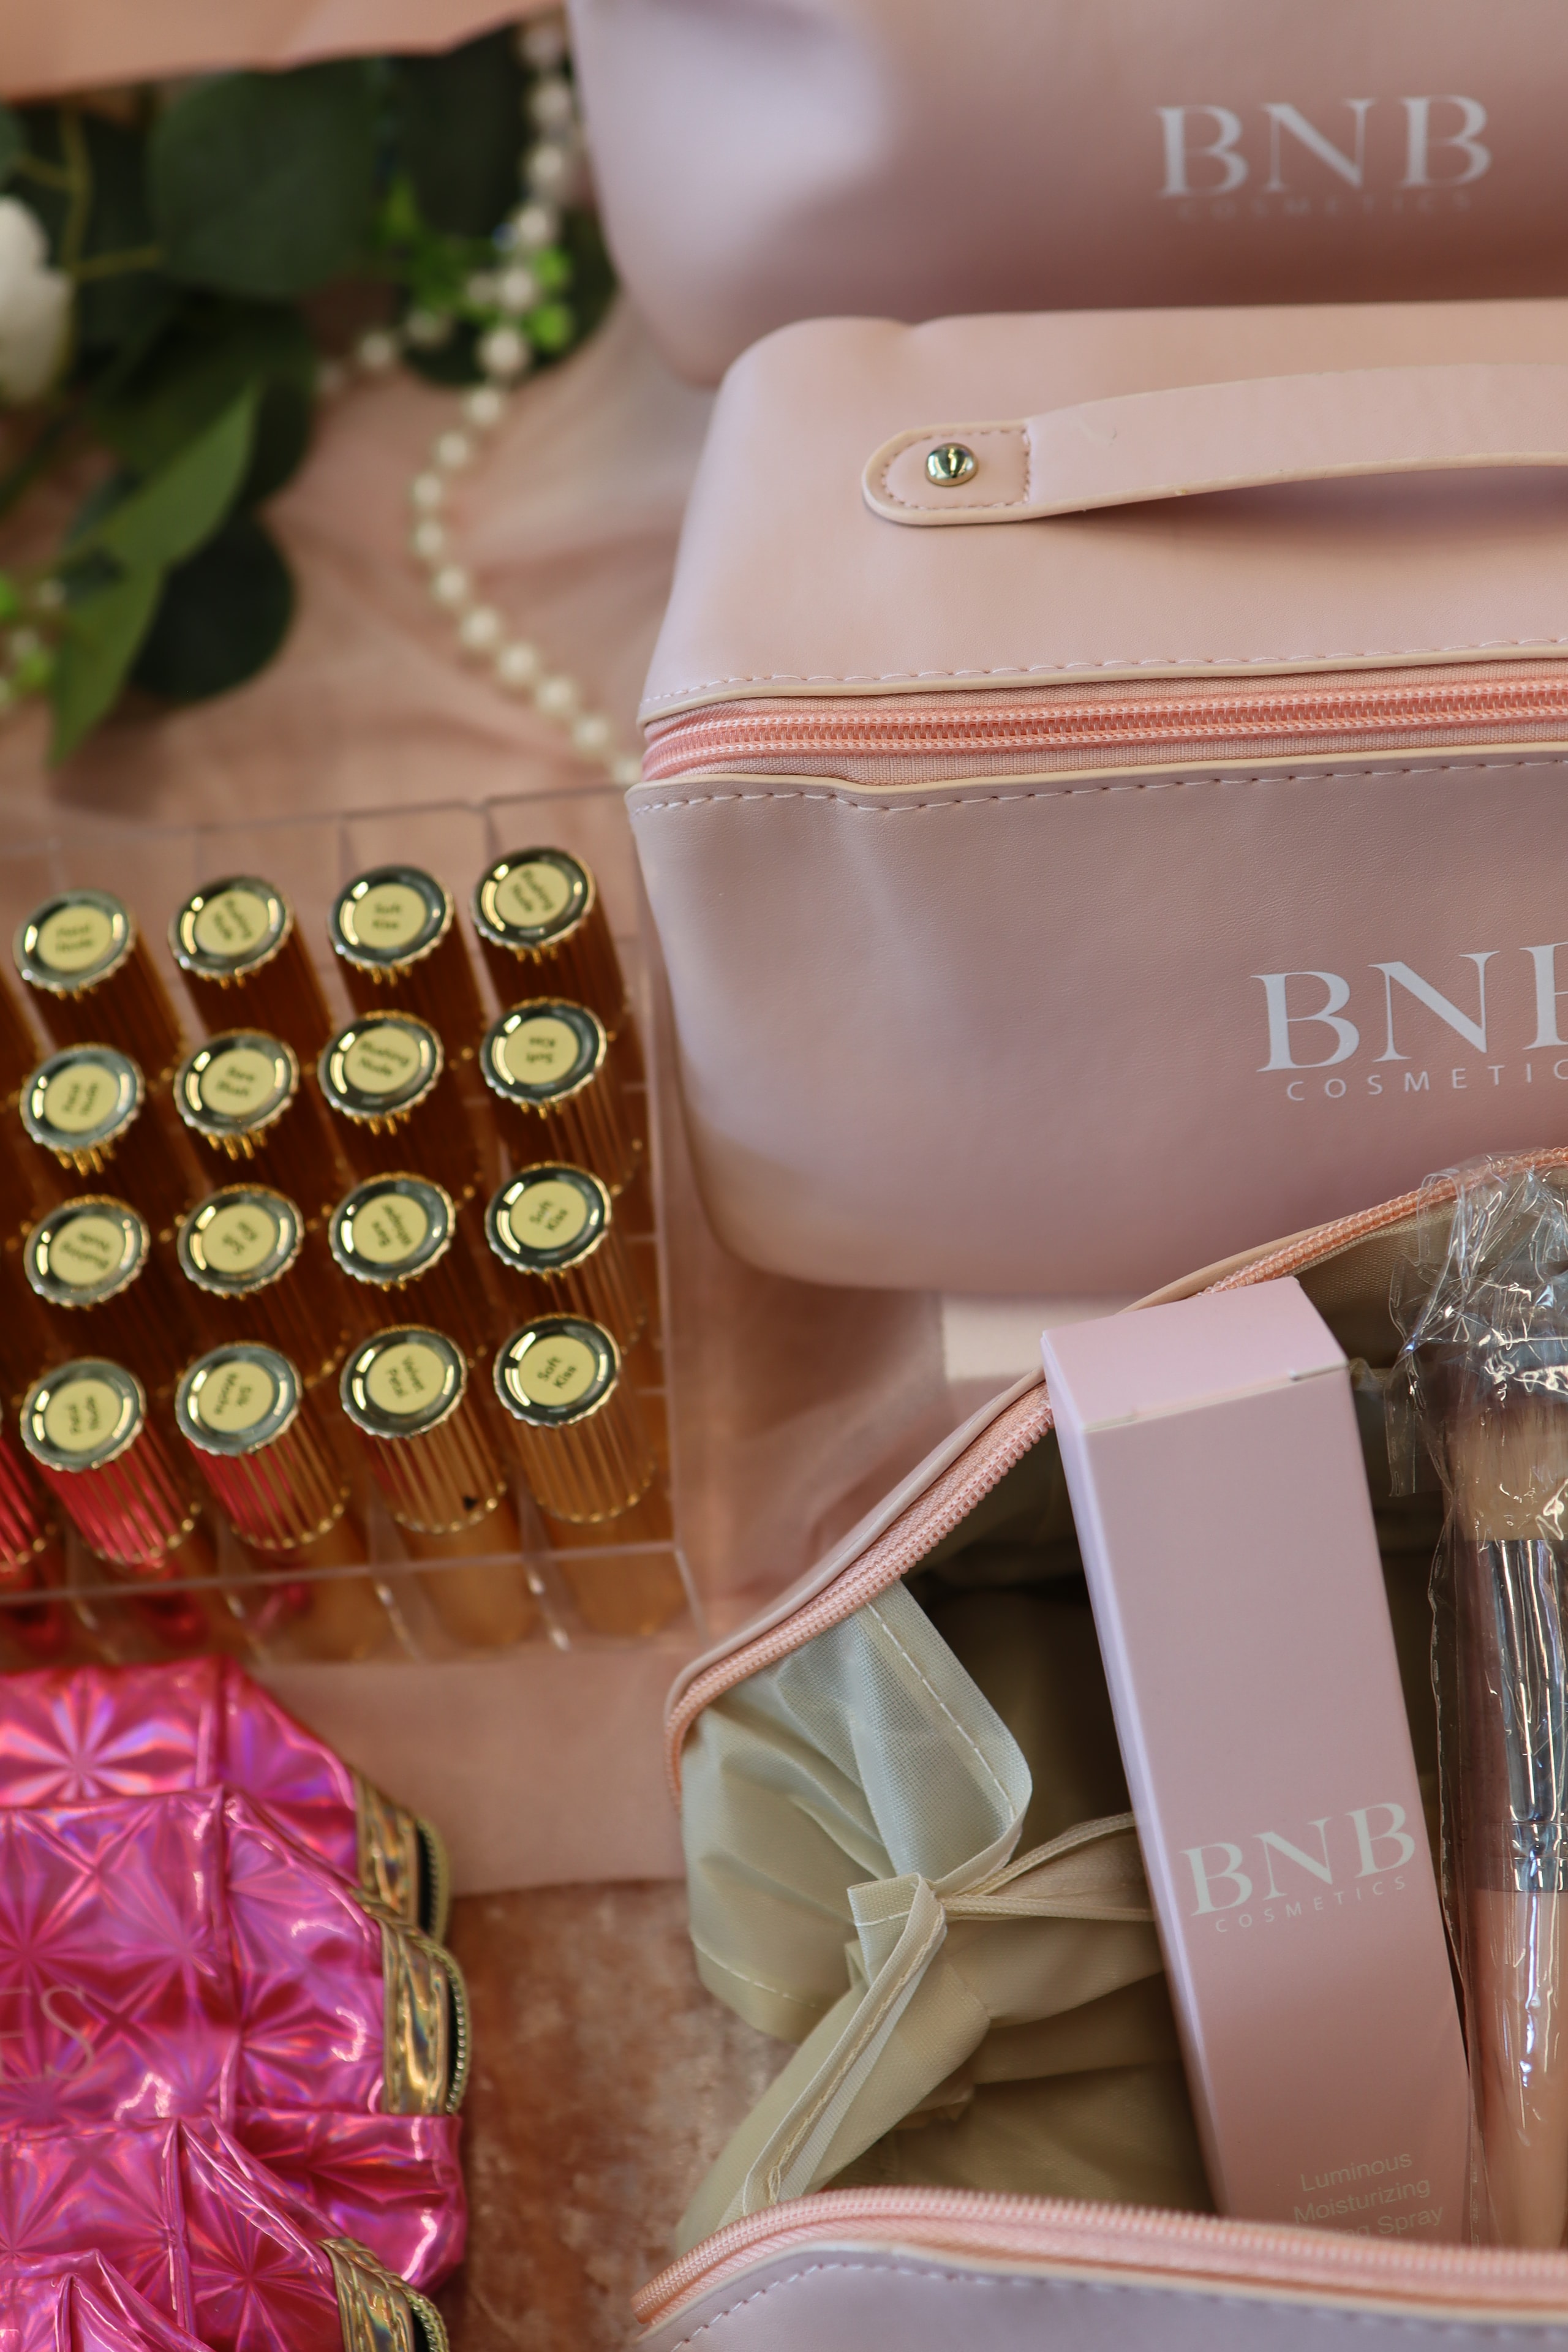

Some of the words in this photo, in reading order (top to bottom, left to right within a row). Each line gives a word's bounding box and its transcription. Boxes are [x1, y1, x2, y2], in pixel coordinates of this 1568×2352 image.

[1155, 94, 1492, 197] BNB
[537, 1355, 562, 1382] Soft
[552, 1365, 577, 1389] Kiss
[1178, 1803, 1415, 1916] BNB
[1215, 1875, 1406, 1932] COSMETICS
[1300, 2153, 1413, 2192] Luminous
[1293, 2179, 1431, 2224] Moisturizing
[1378, 2206, 1443, 2234] Spray
